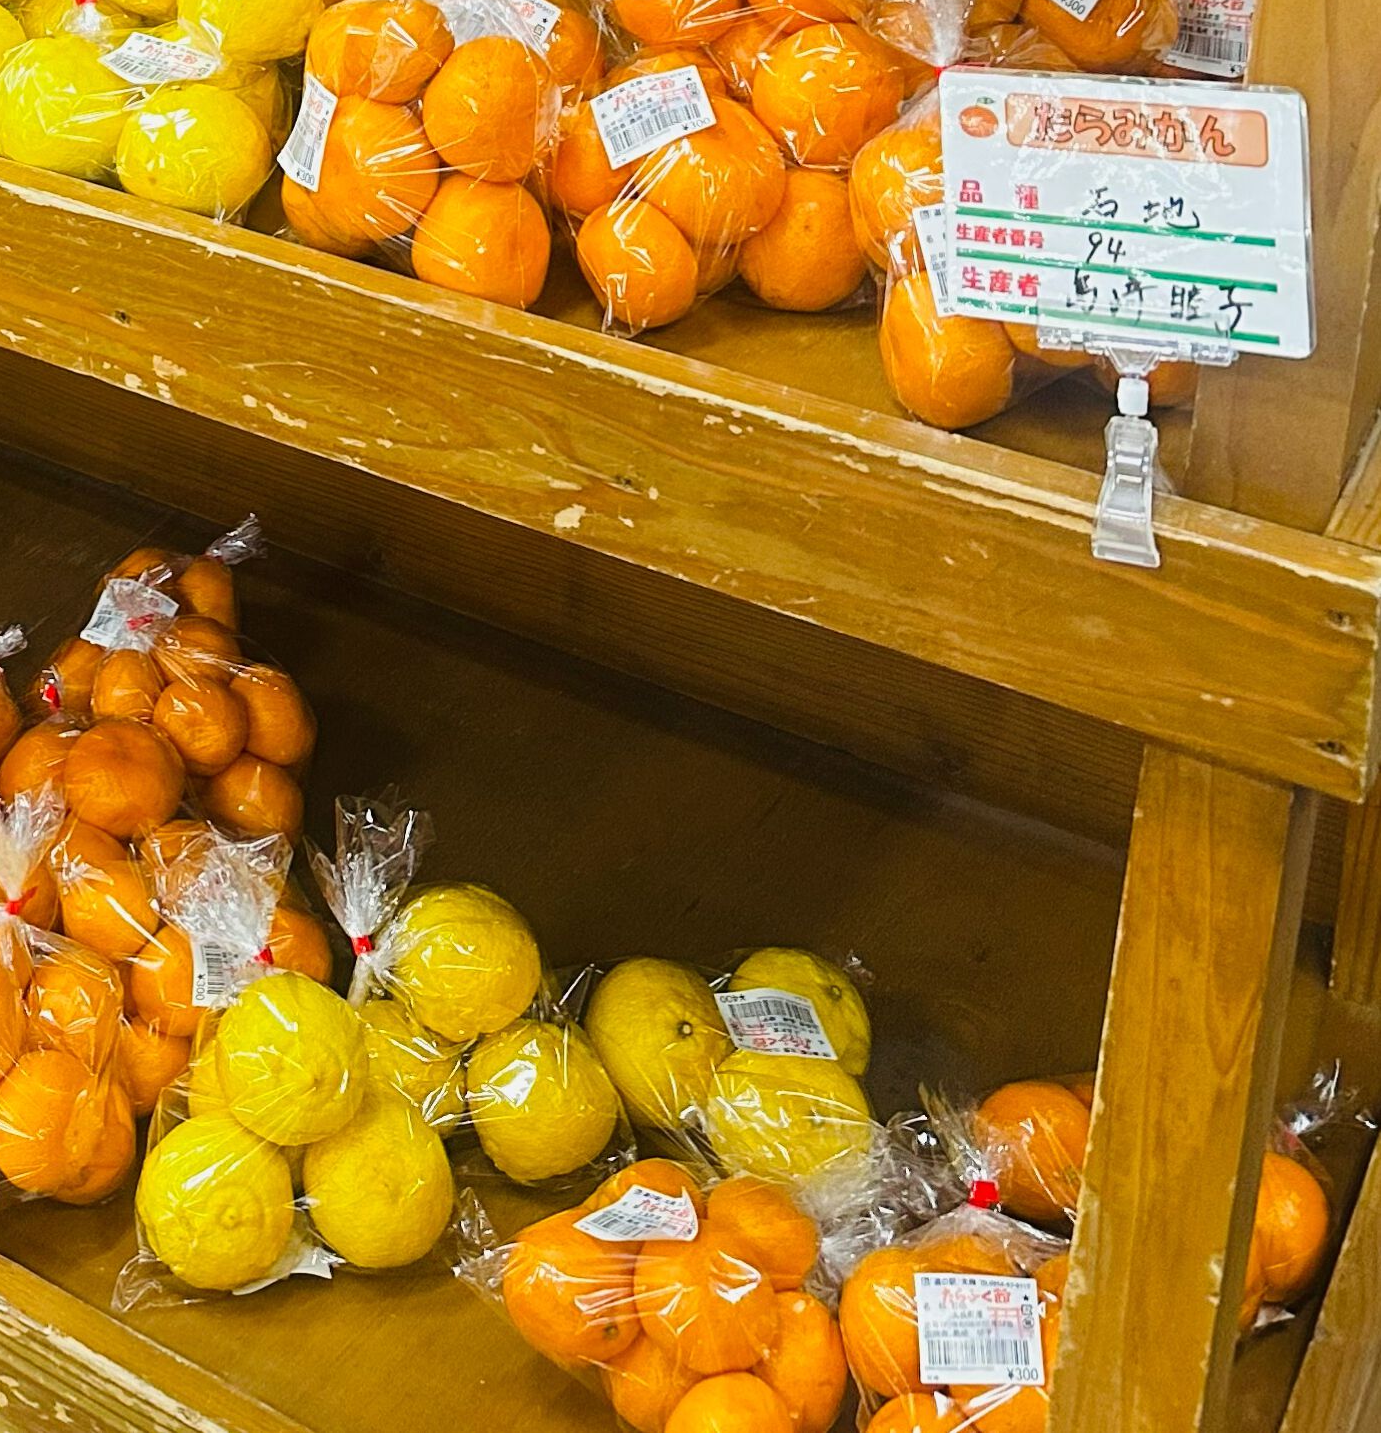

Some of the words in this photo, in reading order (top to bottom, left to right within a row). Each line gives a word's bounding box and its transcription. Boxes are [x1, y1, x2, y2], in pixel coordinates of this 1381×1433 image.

[682, 117, 711, 131] ¥300
[1033, 102, 1237, 158] たらみかん
[295, 168, 316, 187] ¥300
[955, 222, 1045, 250] 生産者番号
[1084, 231, 1127, 264] 94
[960, 265, 1042, 298] 生産者
[1007, 1367, 1039, 1381] ¥300
